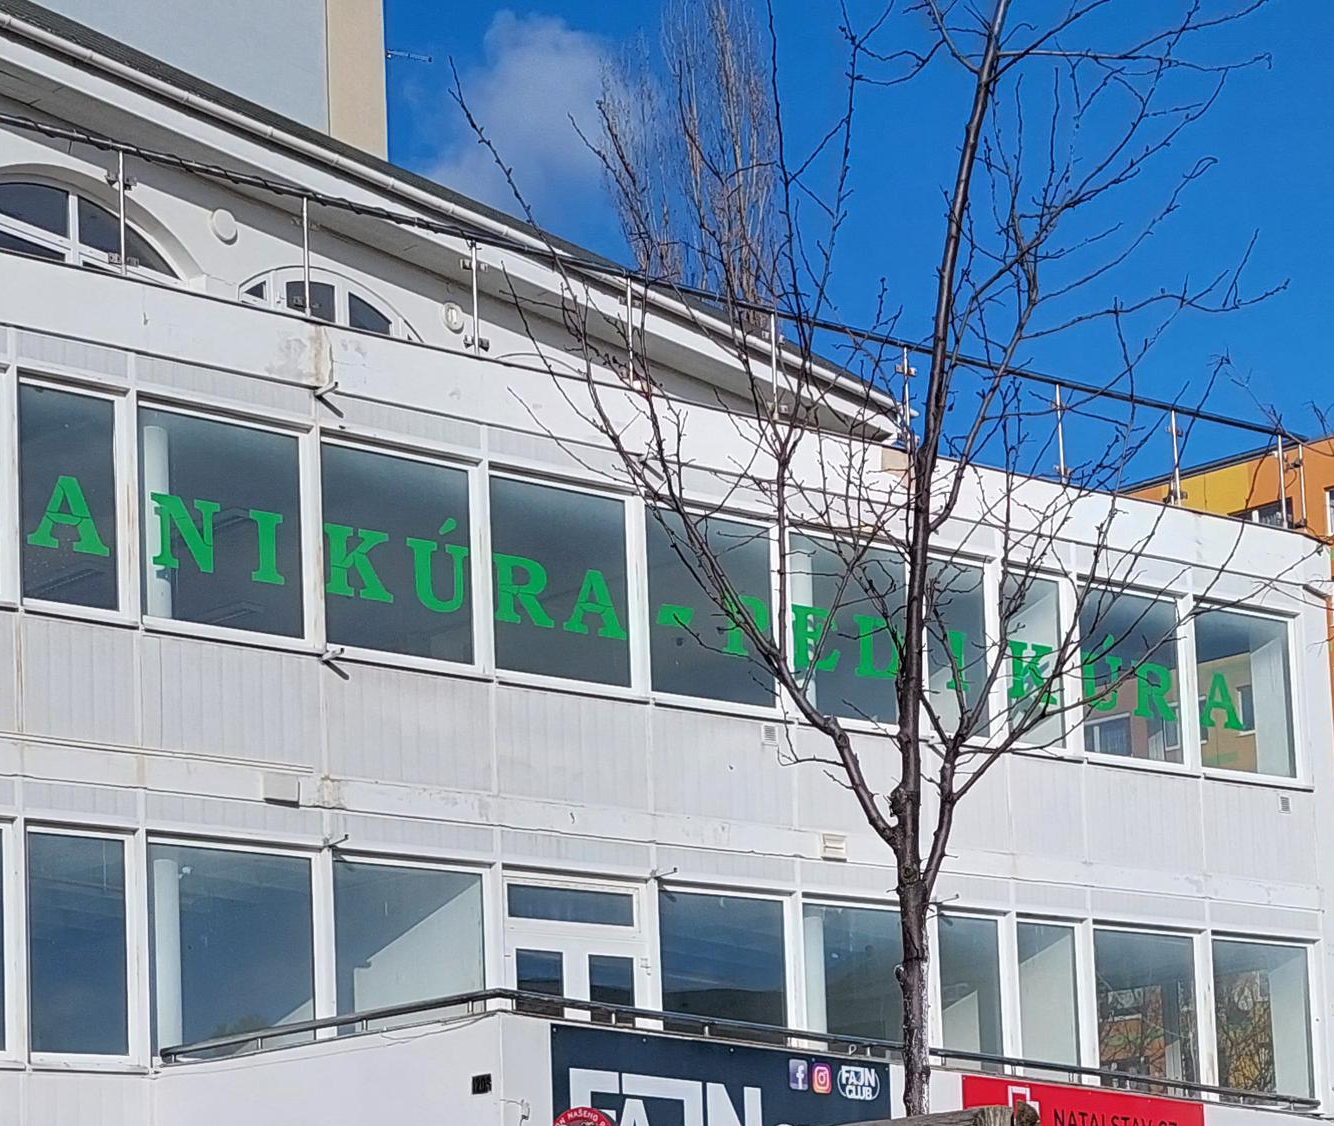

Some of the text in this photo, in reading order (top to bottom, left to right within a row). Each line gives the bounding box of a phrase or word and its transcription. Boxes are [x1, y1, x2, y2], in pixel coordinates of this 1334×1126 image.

[722, 593, 1245, 731] PEDIKÚRA
[841, 1065, 875, 1087] FAJN
[845, 1084, 873, 1100] CLUB
